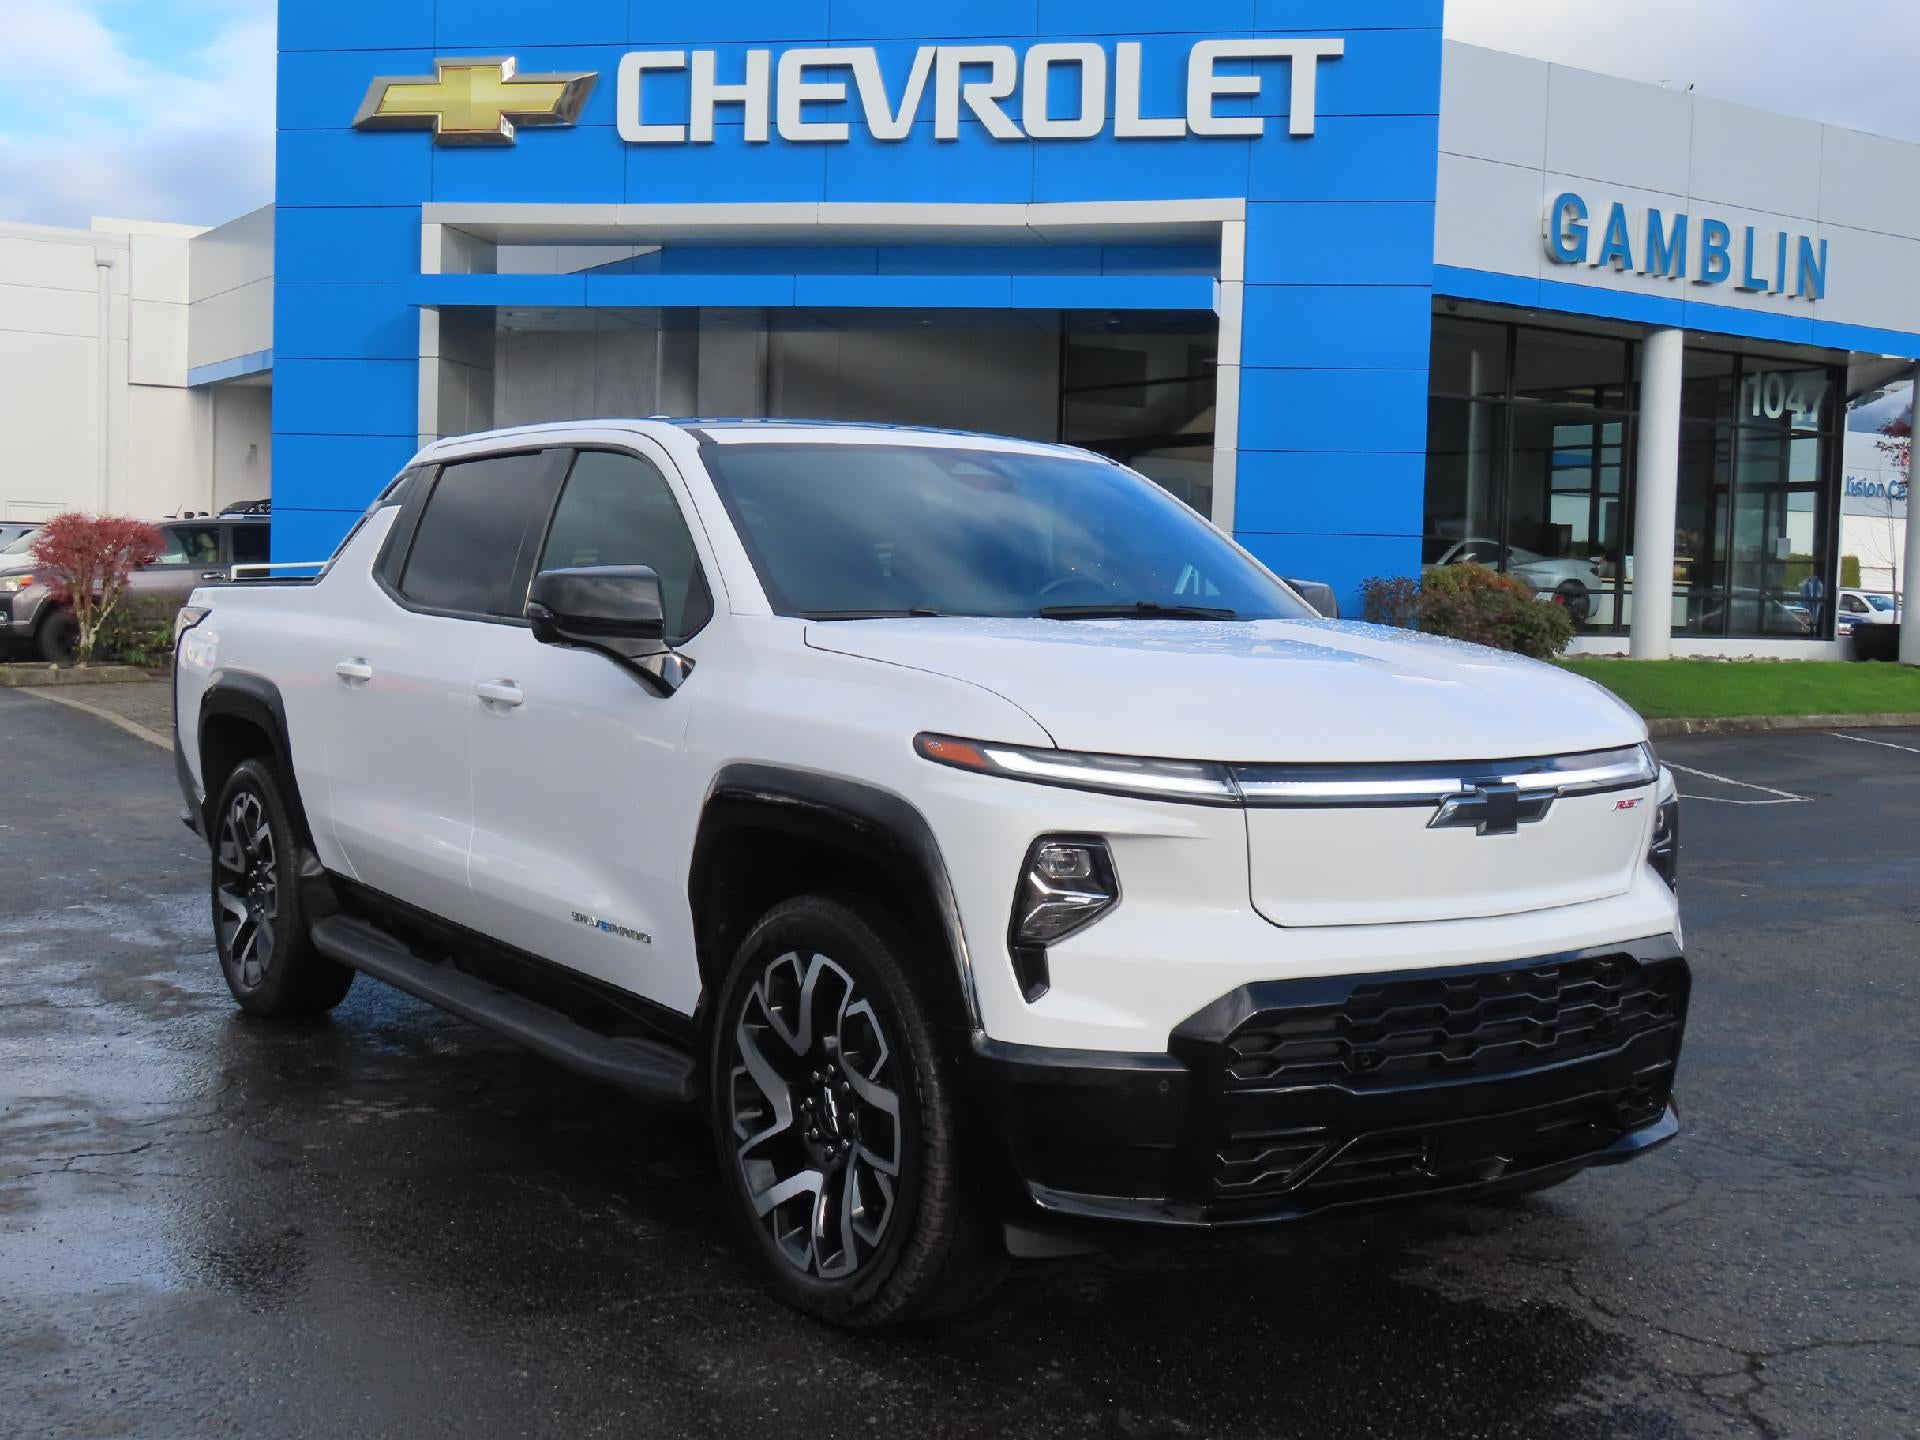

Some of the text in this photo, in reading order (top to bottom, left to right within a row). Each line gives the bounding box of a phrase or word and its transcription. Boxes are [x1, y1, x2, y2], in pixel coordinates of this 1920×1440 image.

[616, 38, 1345, 144] CHEVROLET
[1545, 192, 1828, 301] GAMBLIN
[1746, 371, 1830, 424] 1047
